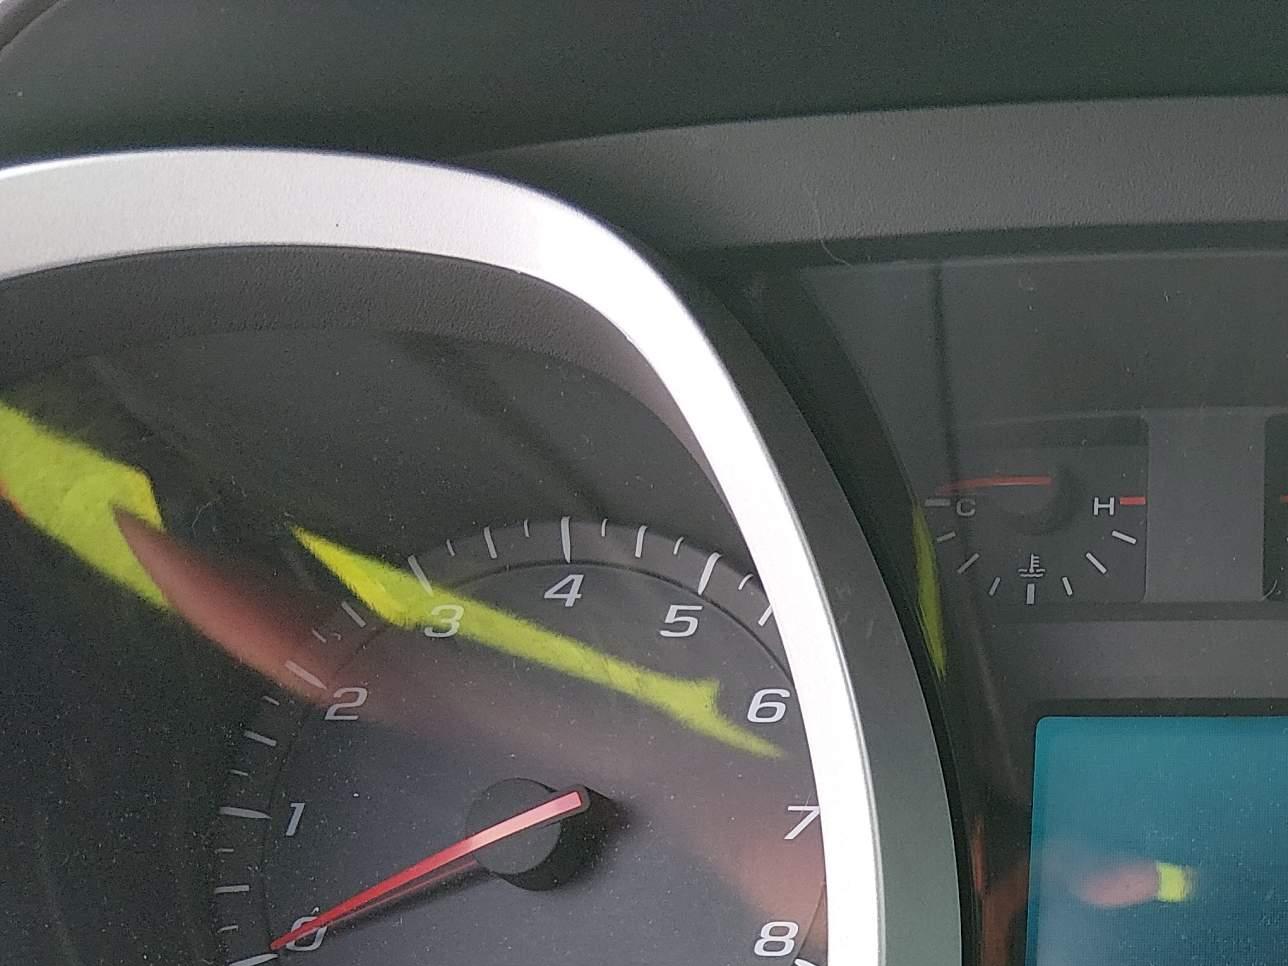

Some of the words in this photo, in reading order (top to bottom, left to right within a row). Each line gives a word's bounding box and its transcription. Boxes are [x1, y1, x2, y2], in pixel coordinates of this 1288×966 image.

[956, 497, 976, 517] C
[1094, 497, 1115, 516] H
[544, 574, 585, 607] 4
[424, 605, 465, 638] 3
[659, 605, 702, 638] 5
[325, 688, 368, 721] 2
[747, 689, 790, 722] 6
[285, 803, 305, 836] 1
[784, 806, 820, 839] 7
[285, 917, 326, 951] 0
[754, 922, 798, 956] 8
